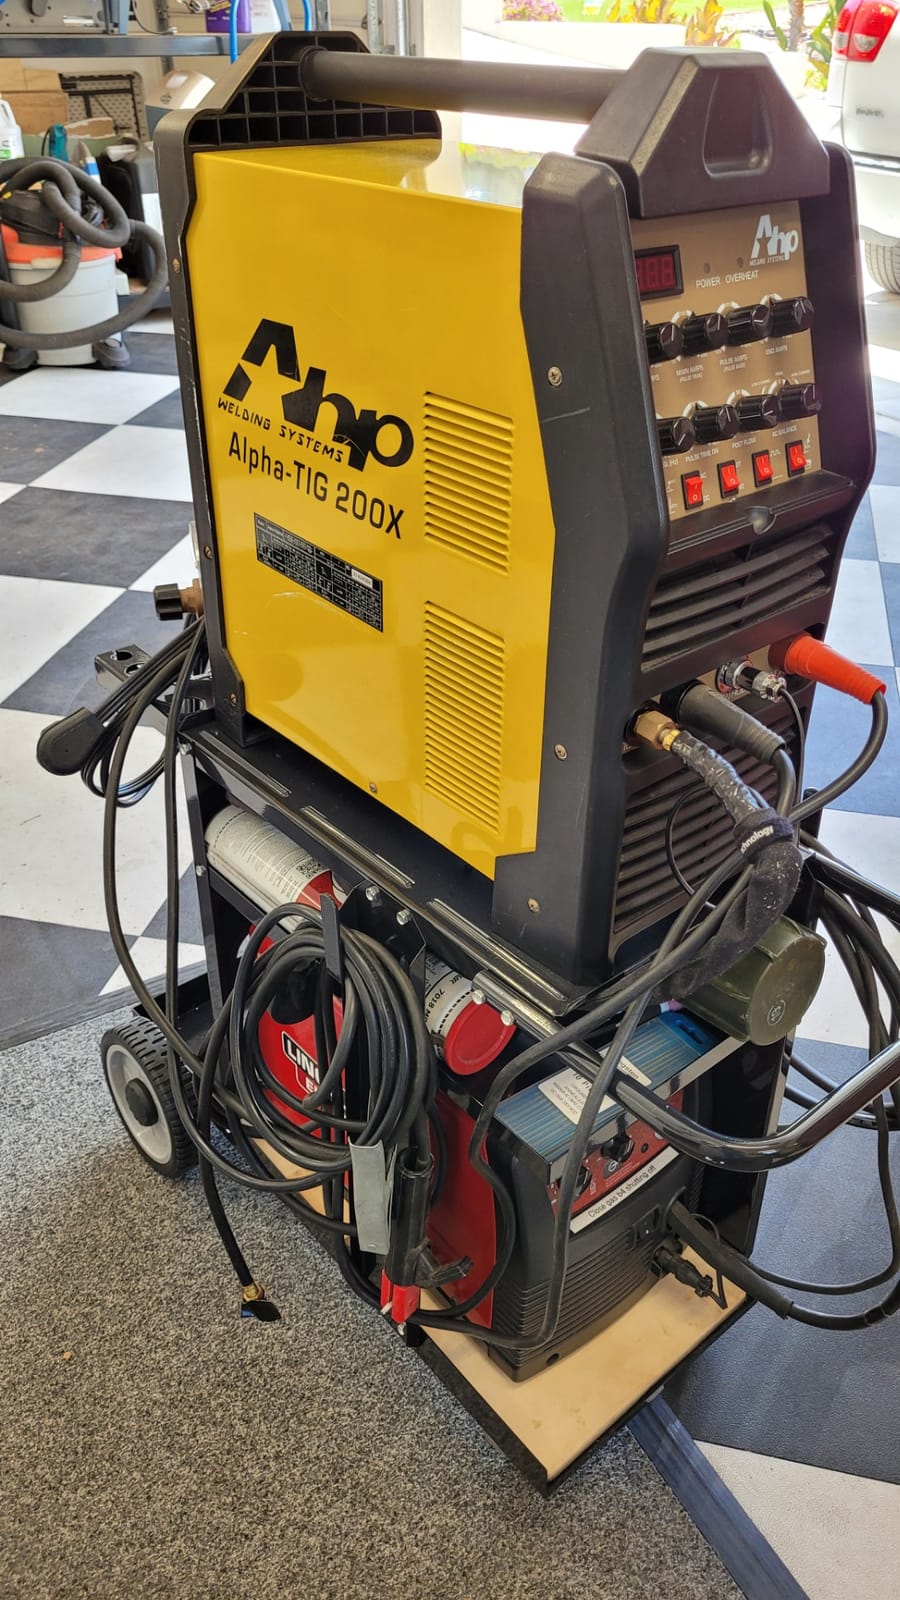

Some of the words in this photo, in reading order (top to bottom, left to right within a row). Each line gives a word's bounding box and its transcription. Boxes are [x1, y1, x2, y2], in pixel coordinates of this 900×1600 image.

[695, 276, 721, 289] POWER
[725, 269, 760, 285] OVERHEAT
[217, 397, 271, 430] WELDING
[279, 425, 344, 463] SYSTEMS
[685, 453, 699, 463] PULSE
[711, 447, 720, 455] ON
[228, 431, 329, 502] Alpha-TIG
[335, 482, 405, 540] 200X
[428, 988, 446, 1009] 7018
[587, 1203, 607, 1218] Close
[605, 1194, 619, 1207] gas
[616, 1188, 626, 1198] b4
[624, 1171, 649, 1192] shutting
[647, 1164, 657, 1174] off
